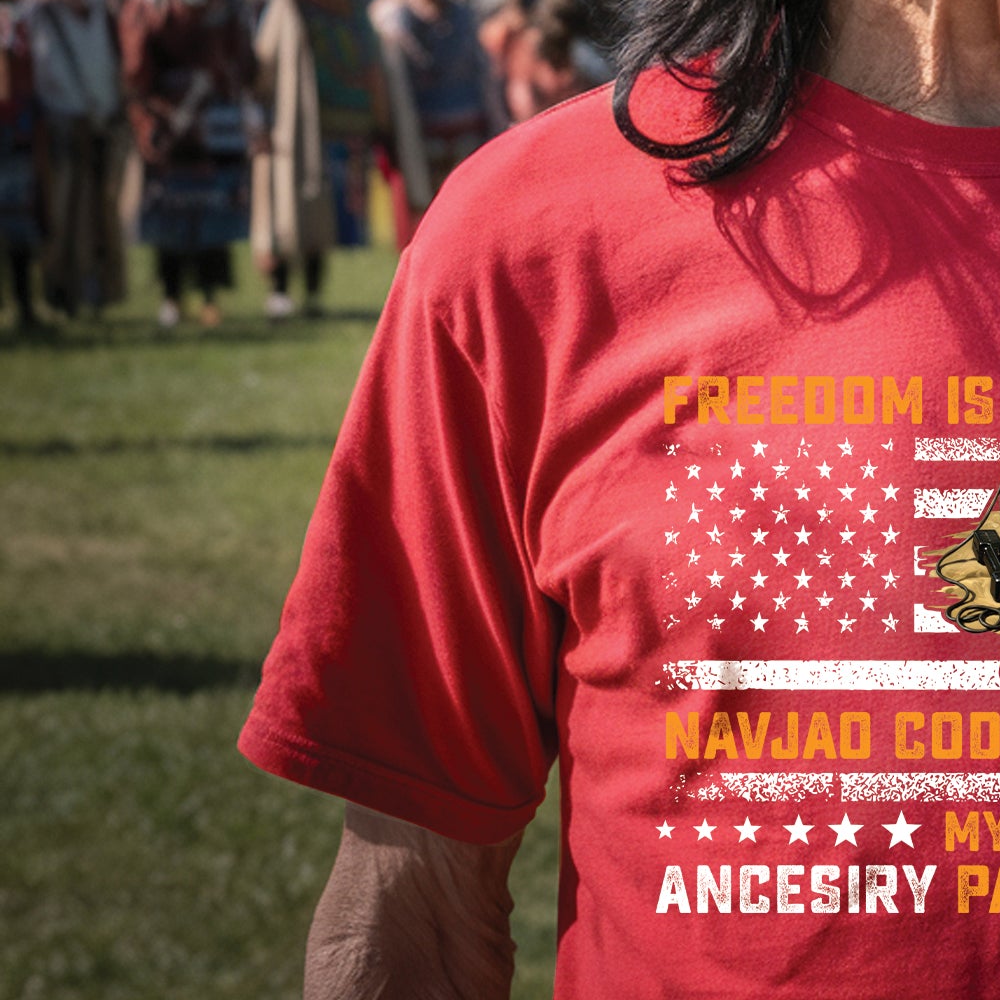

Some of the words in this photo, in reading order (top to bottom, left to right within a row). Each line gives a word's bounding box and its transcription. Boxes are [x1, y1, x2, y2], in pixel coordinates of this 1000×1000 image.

[664, 376, 923, 425] FREEDOM
[948, 376, 993, 425] IS
[665, 711, 871, 760] NAVJAO
[655, 864, 937, 914] ANCESIRY
